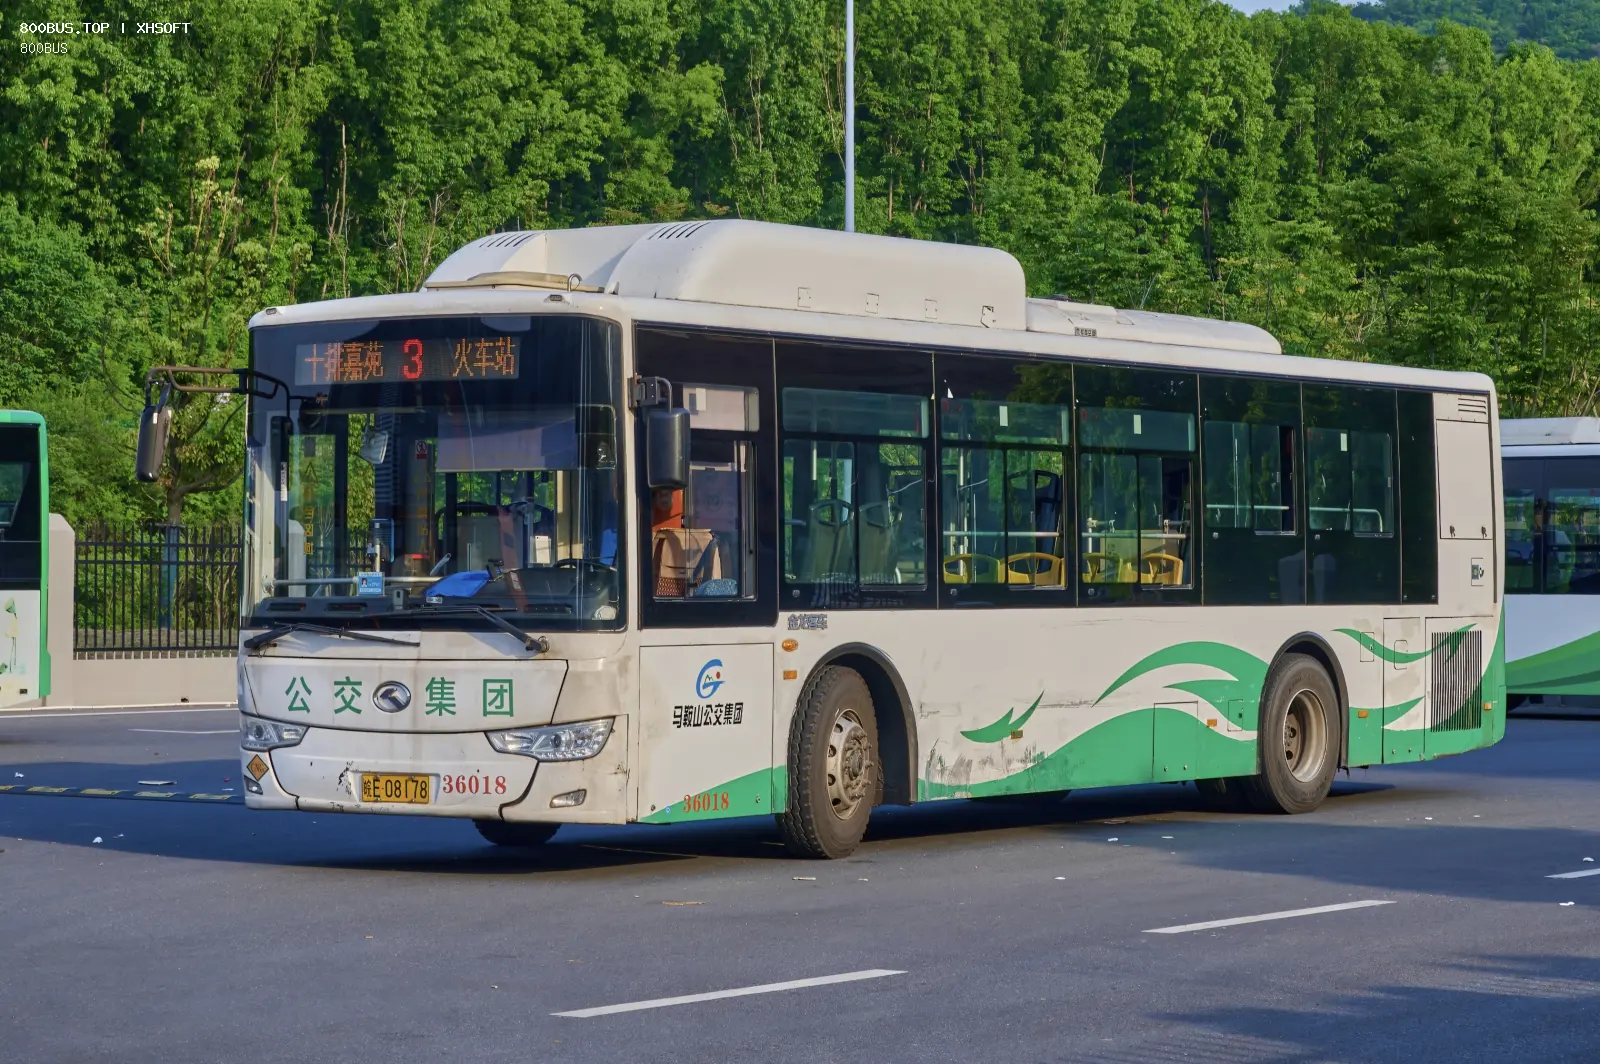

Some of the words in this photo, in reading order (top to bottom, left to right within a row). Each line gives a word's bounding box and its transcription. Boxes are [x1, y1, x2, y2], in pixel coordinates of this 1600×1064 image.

[403, 339, 423, 379] 3
[452, 337, 516, 376] 火车站
[285, 676, 515, 717] 公交集团
[672, 702, 744, 728] 马鞍山公交集团
[442, 774, 507, 795] 36018
[683, 791, 730, 813] 36018
